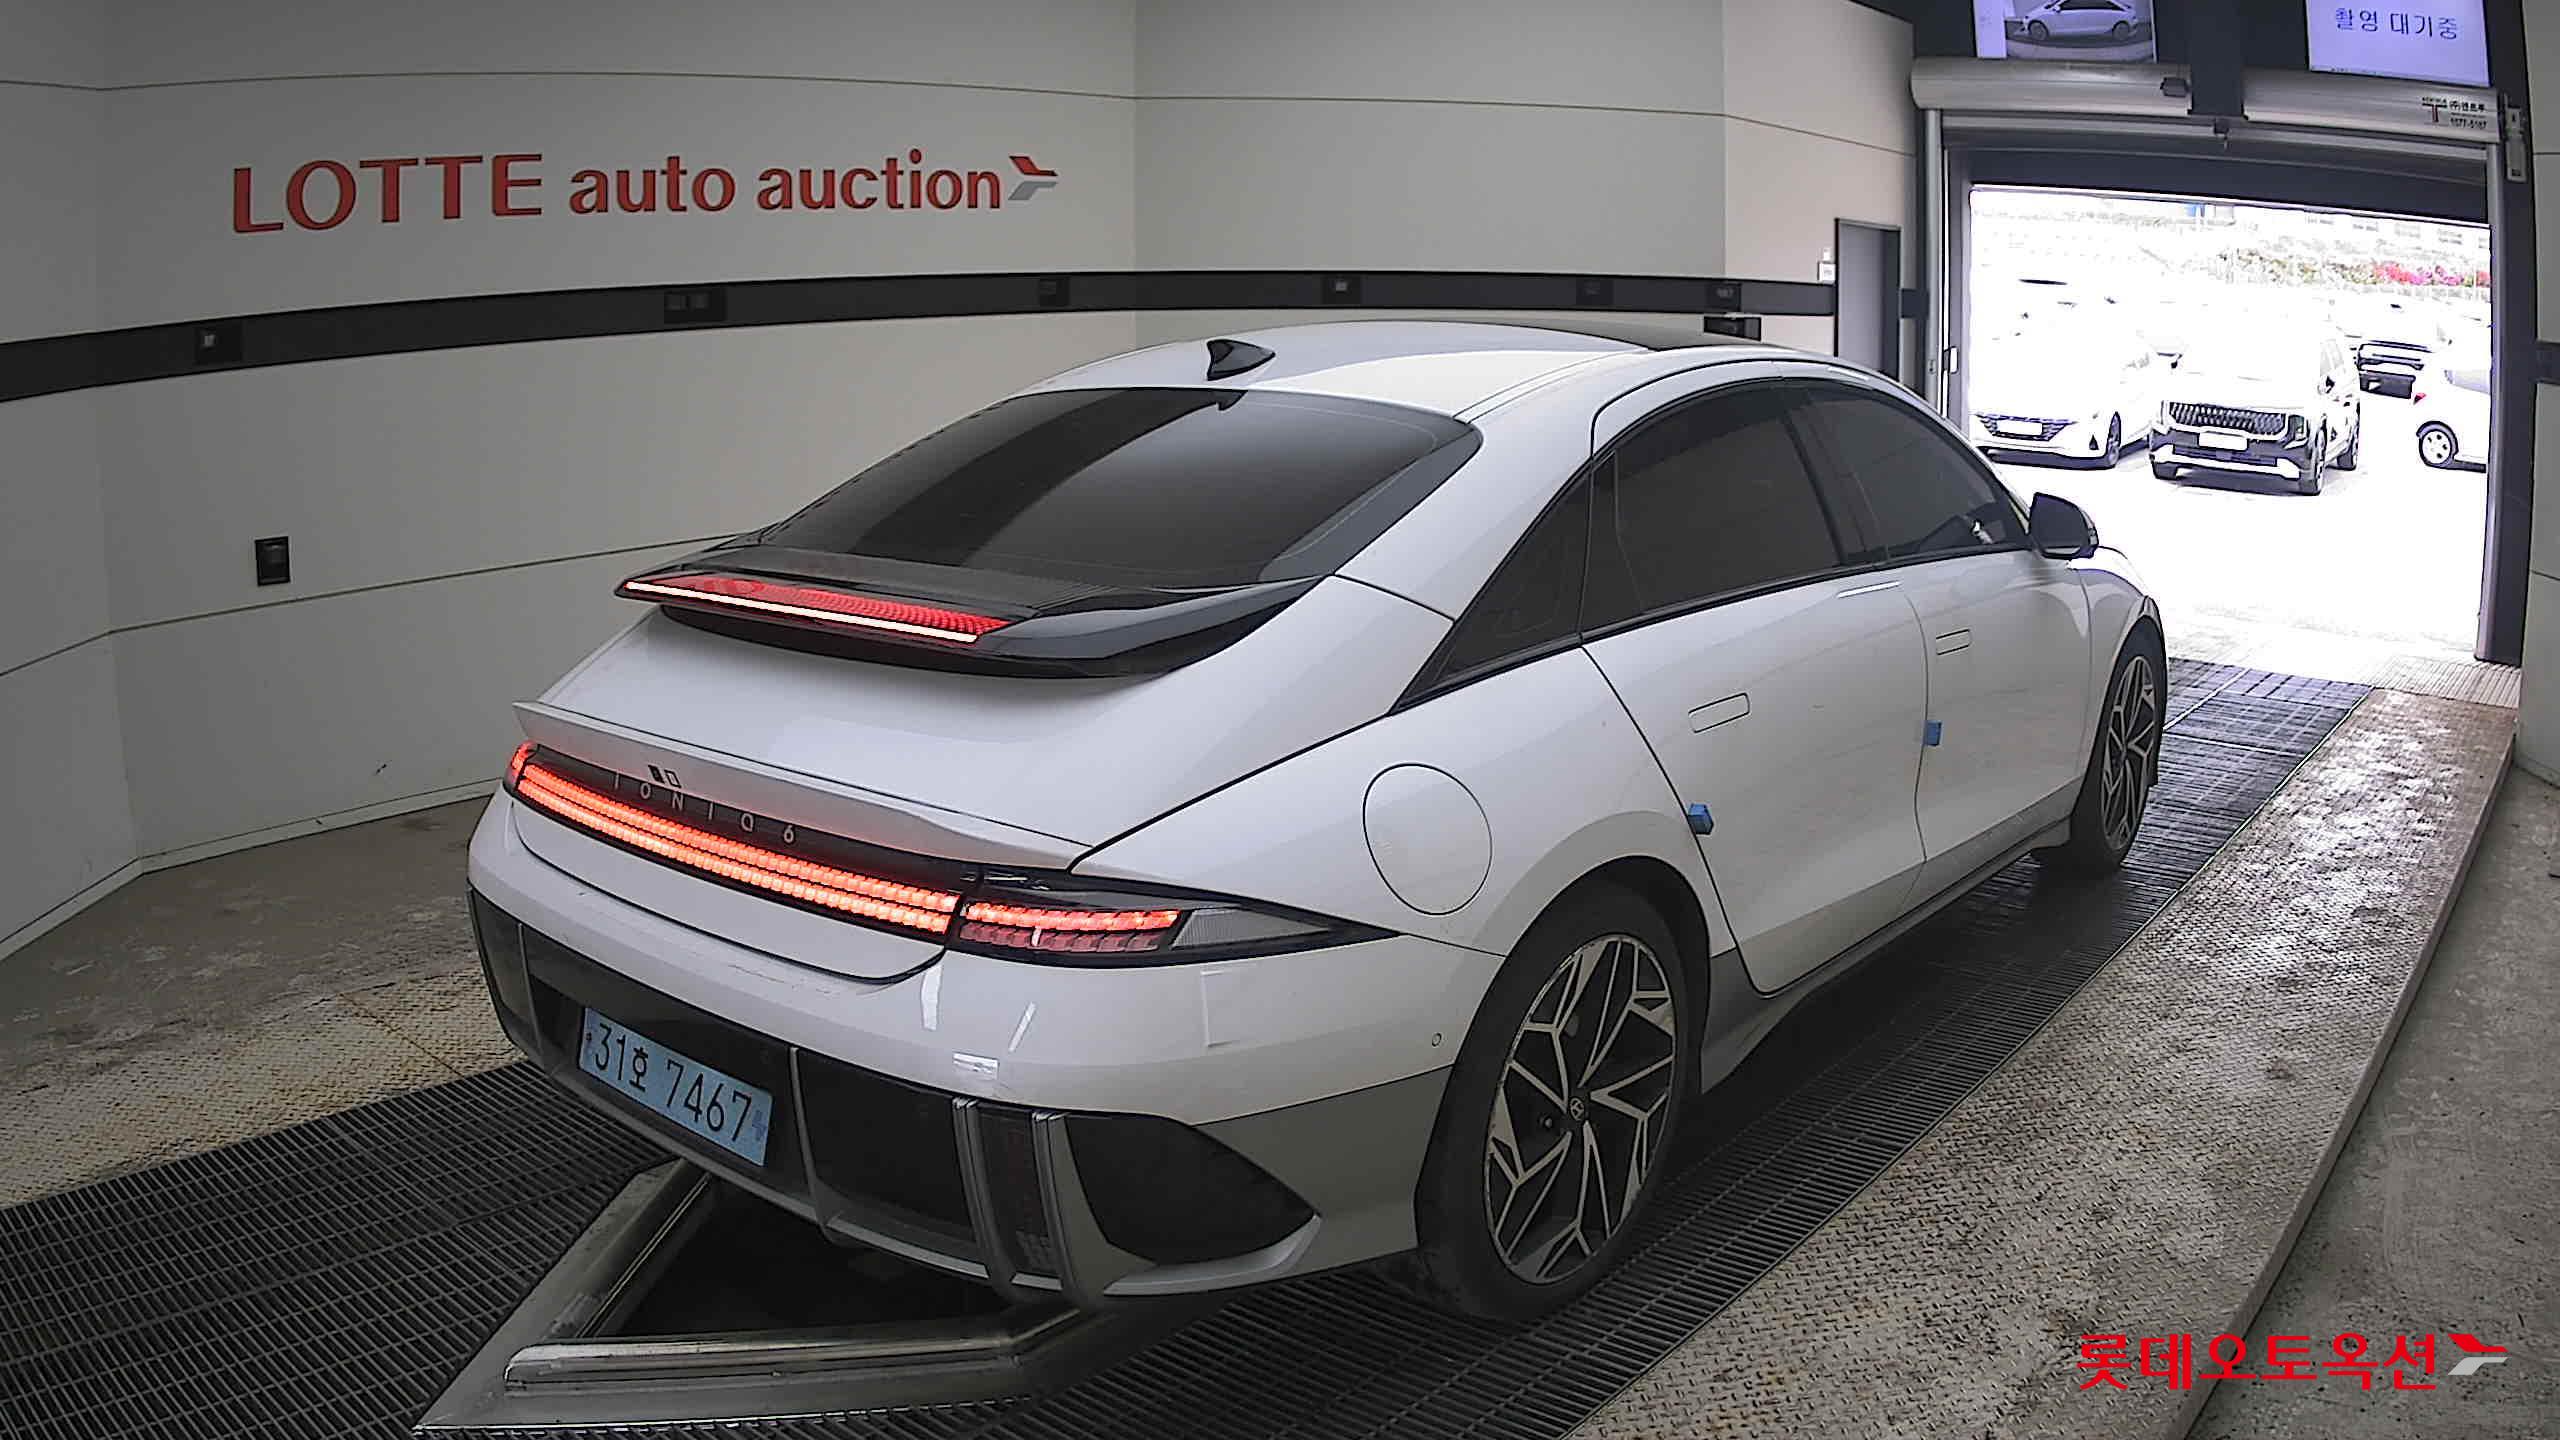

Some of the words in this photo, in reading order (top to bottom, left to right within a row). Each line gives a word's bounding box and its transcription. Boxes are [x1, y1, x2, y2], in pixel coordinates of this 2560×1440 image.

[2336, 8, 2378, 31] 촬영
[2390, 13, 2457, 39] 대기중
[233, 153, 543, 234] LOTTE
[569, 156, 737, 215] auto
[757, 148, 1002, 212] auction
[614, 773, 756, 833] IONIQ
[783, 825, 797, 844] 6
[595, 1022, 649, 1093] 31호
[665, 1058, 753, 1142] 7467
